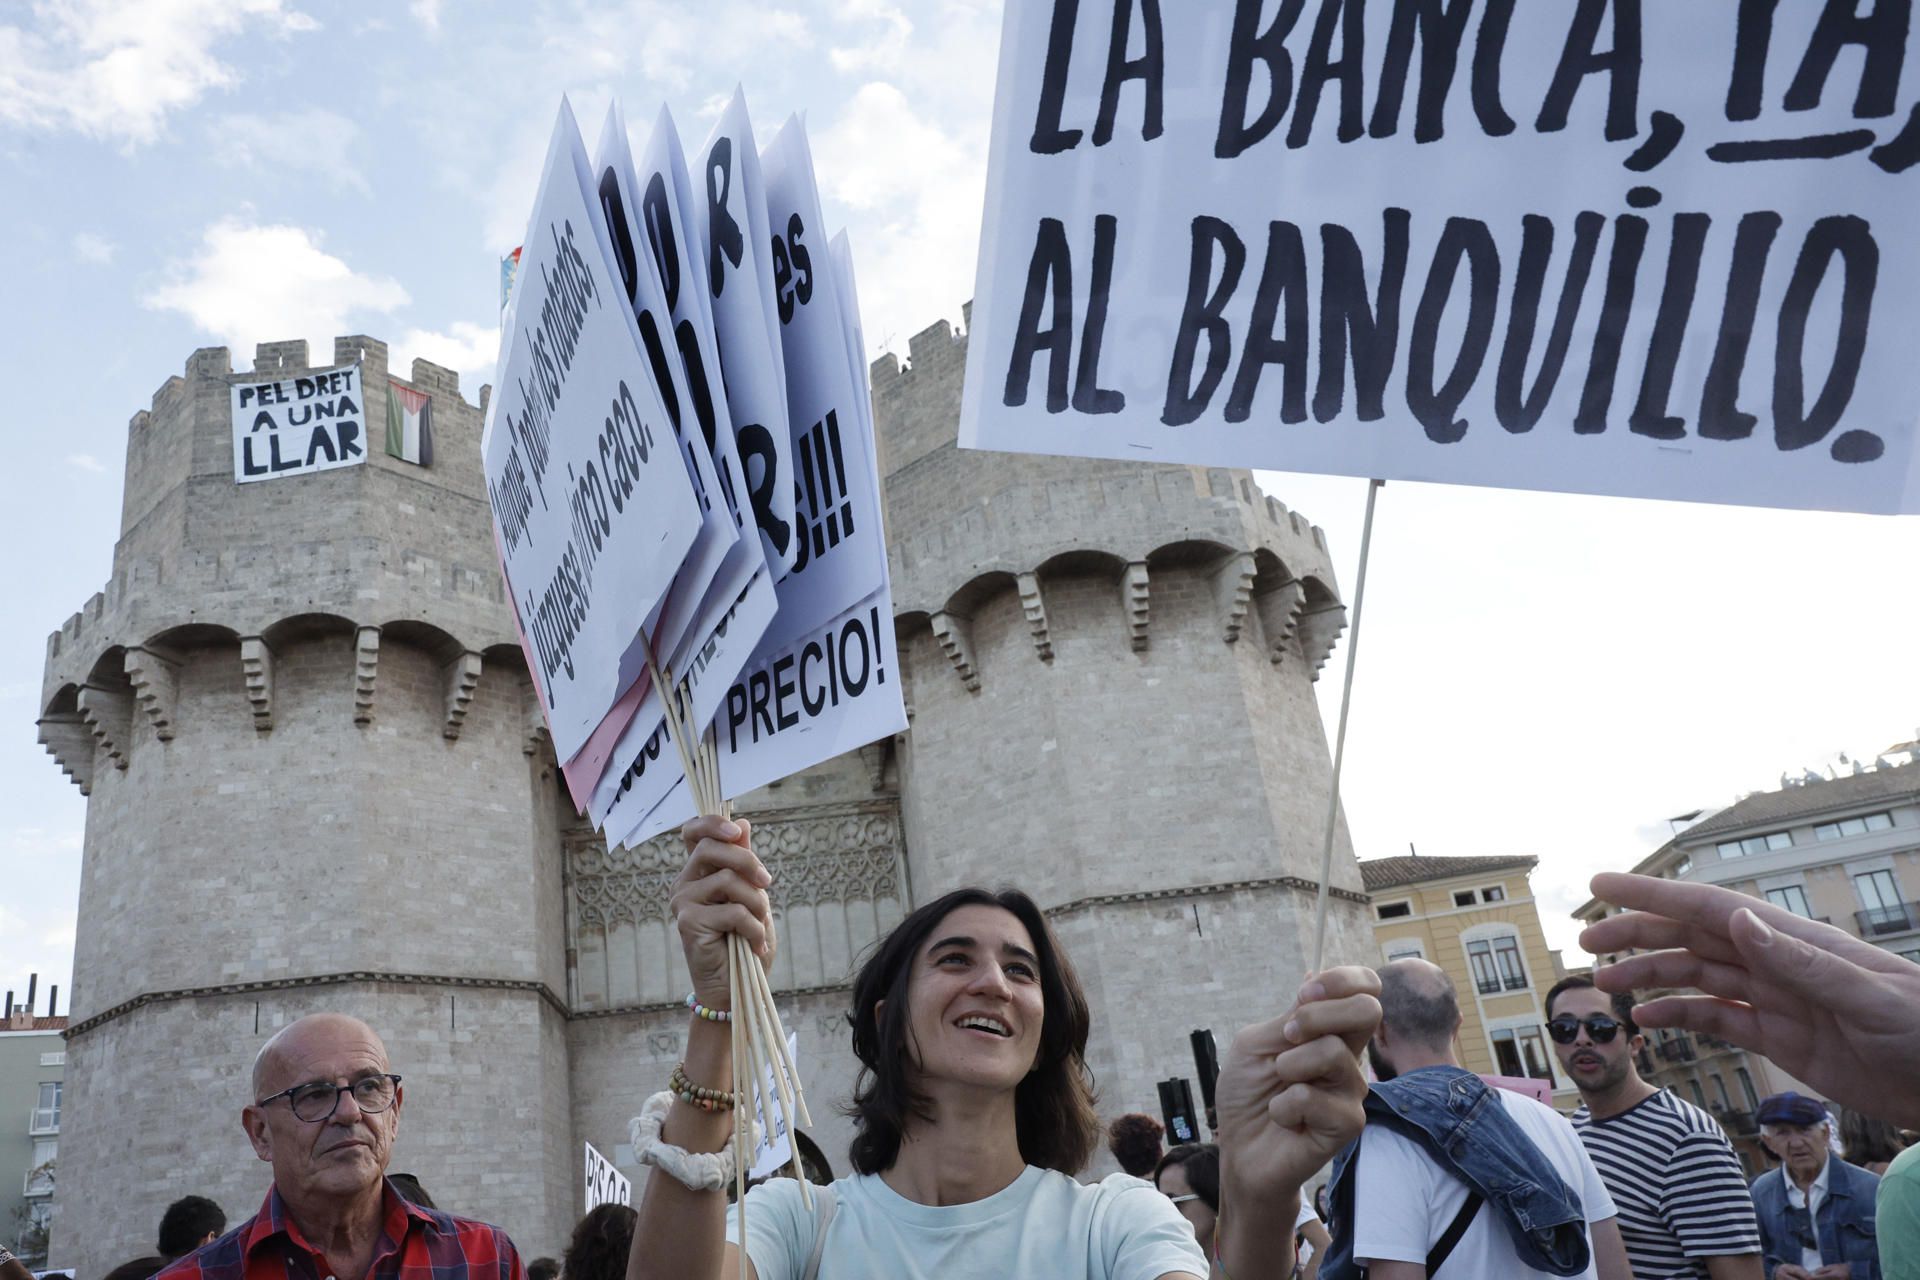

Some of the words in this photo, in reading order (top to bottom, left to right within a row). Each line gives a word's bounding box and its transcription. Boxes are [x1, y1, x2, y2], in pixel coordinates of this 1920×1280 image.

[1030, 0, 1164, 155] LA
[1215, 0, 1684, 171] BANCA,
[525, 327, 560, 420] los
[541, 219, 601, 383] robados,
[1003, 214, 1125, 414] AL
[240, 382, 289, 408] PEL
[295, 371, 353, 400] DRET
[243, 420, 362, 476] LLAR
[251, 410, 278, 433] A
[288, 396, 359, 426] UNA
[567, 460, 610, 572] rico
[599, 380, 654, 514] caco.
[726, 606, 885, 754] PRECIO!
